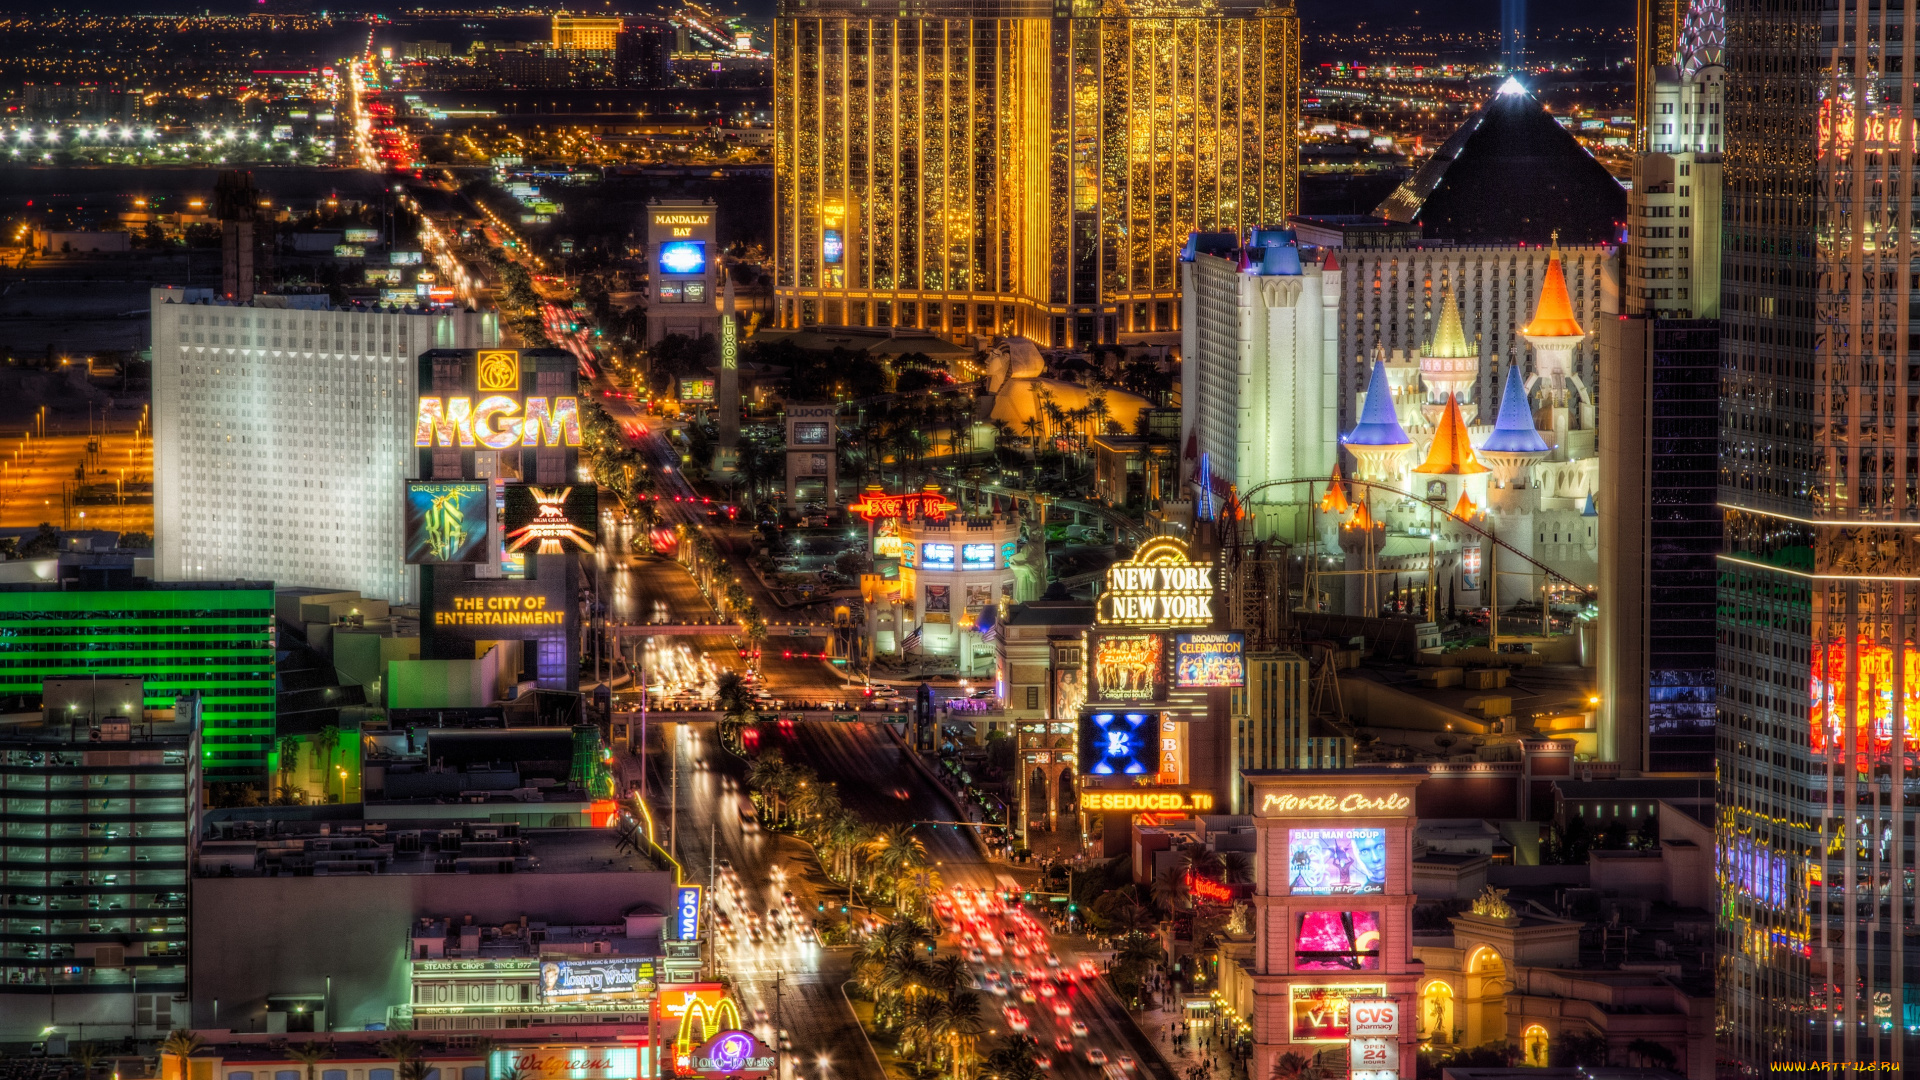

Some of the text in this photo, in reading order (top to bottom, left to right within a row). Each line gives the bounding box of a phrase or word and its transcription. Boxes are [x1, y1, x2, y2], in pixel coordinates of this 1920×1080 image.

[656, 215, 709, 224] MANDALAY
[673, 228, 691, 236] BAY
[723, 315, 736, 369] LUXOR
[787, 408, 835, 417] LUXOR
[415, 395, 583, 449] MGM
[411, 485, 440, 493] CIRQUE
[1113, 568, 1213, 590] NEW YORK
[454, 597, 546, 610] THE CITY OF
[1113, 596, 1213, 619] NEW YORK
[435, 612, 565, 625] ENTERTAINMENT
[1191, 634, 1229, 643] BROADWAY
[1179, 642, 1241, 653] CELEBRATION
[1104, 651, 1150, 663] ZUMANITY
[1161, 738, 1177, 773] BAR
[1081, 793, 1101, 809] BE
[1262, 792, 1410, 812] Monte Carlo
[1295, 831, 1319, 839] BLUE
[1322, 831, 1343, 839] MAN
[1356, 1008, 1393, 1023] CVS
[1356, 1023, 1393, 1031] pharmacy
[1363, 1050, 1387, 1060] 24
[512, 1053, 614, 1075] Walgreens
